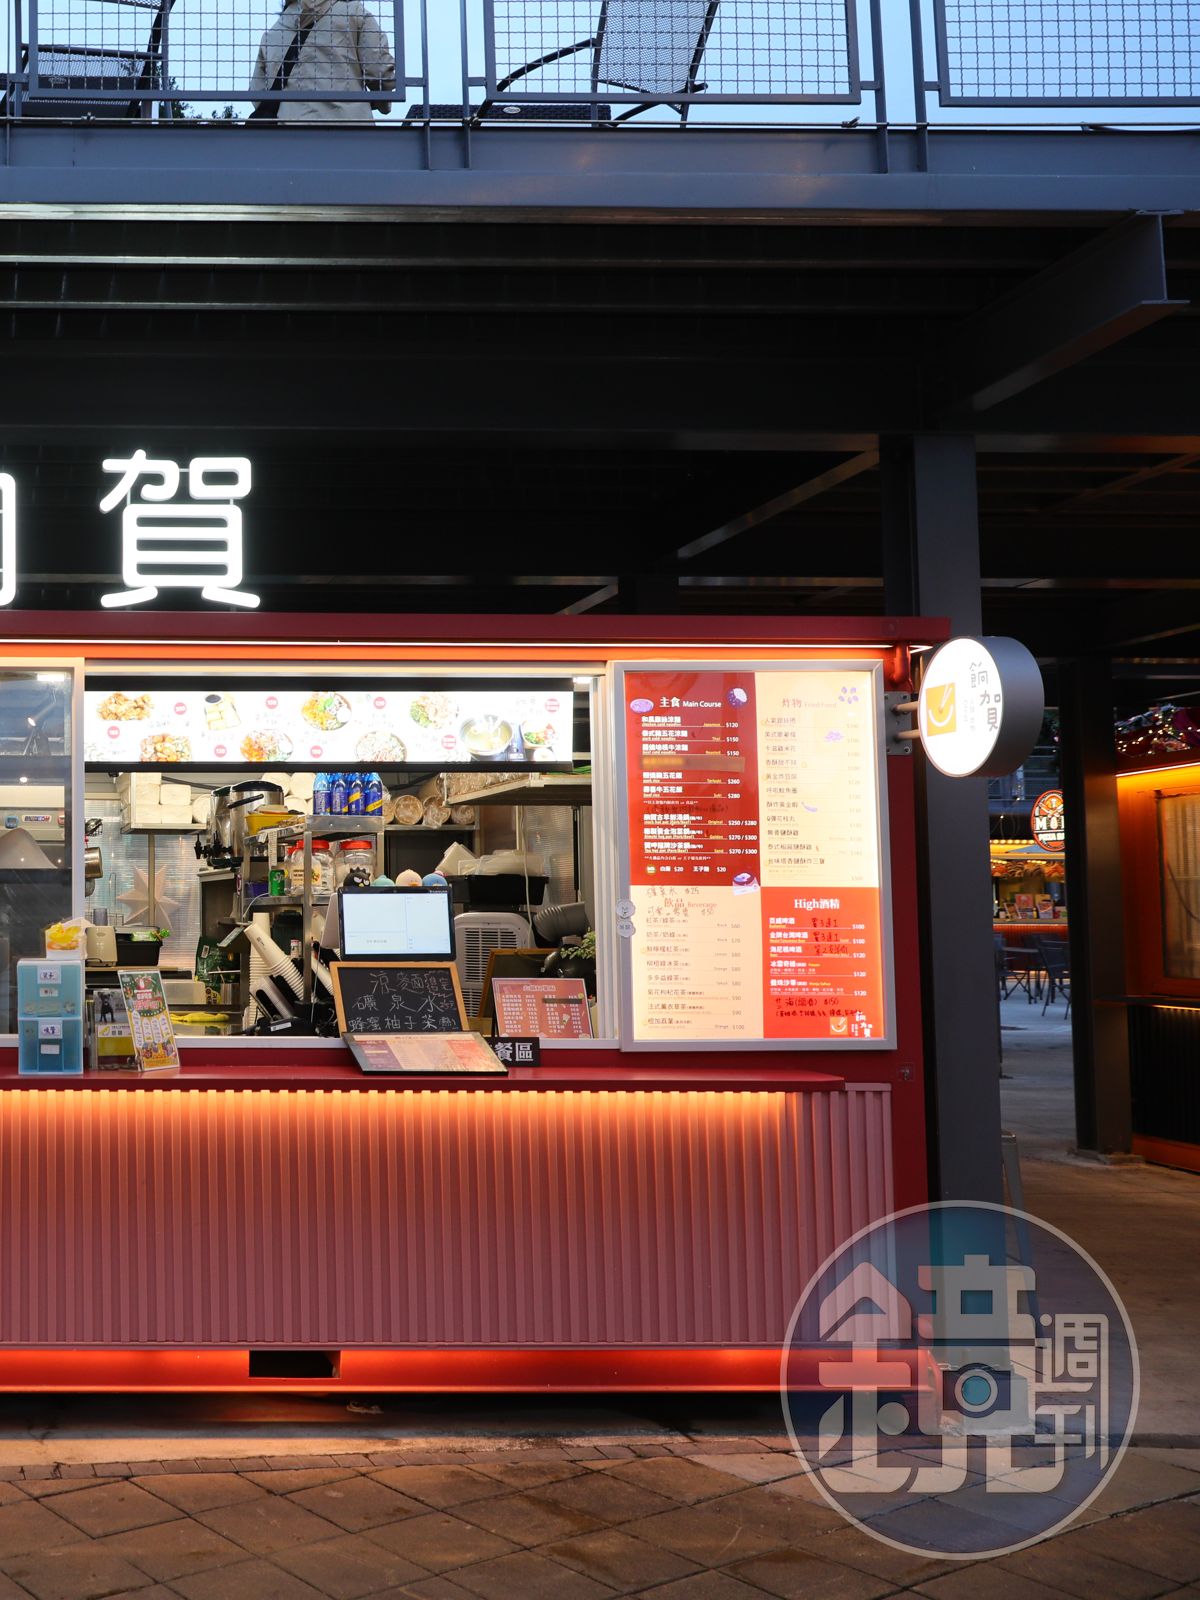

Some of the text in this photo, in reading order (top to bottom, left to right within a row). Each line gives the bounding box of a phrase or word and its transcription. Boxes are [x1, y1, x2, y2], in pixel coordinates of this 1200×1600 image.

[660, 696, 681, 708] 主食
[665, 898, 685, 907] 飲品
[794, 898, 840, 911] High酒精
[370, 971, 426, 994] 涼麵
[352, 994, 445, 1013] 礦泉水
[490, 1042, 533, 1062] 餐區
